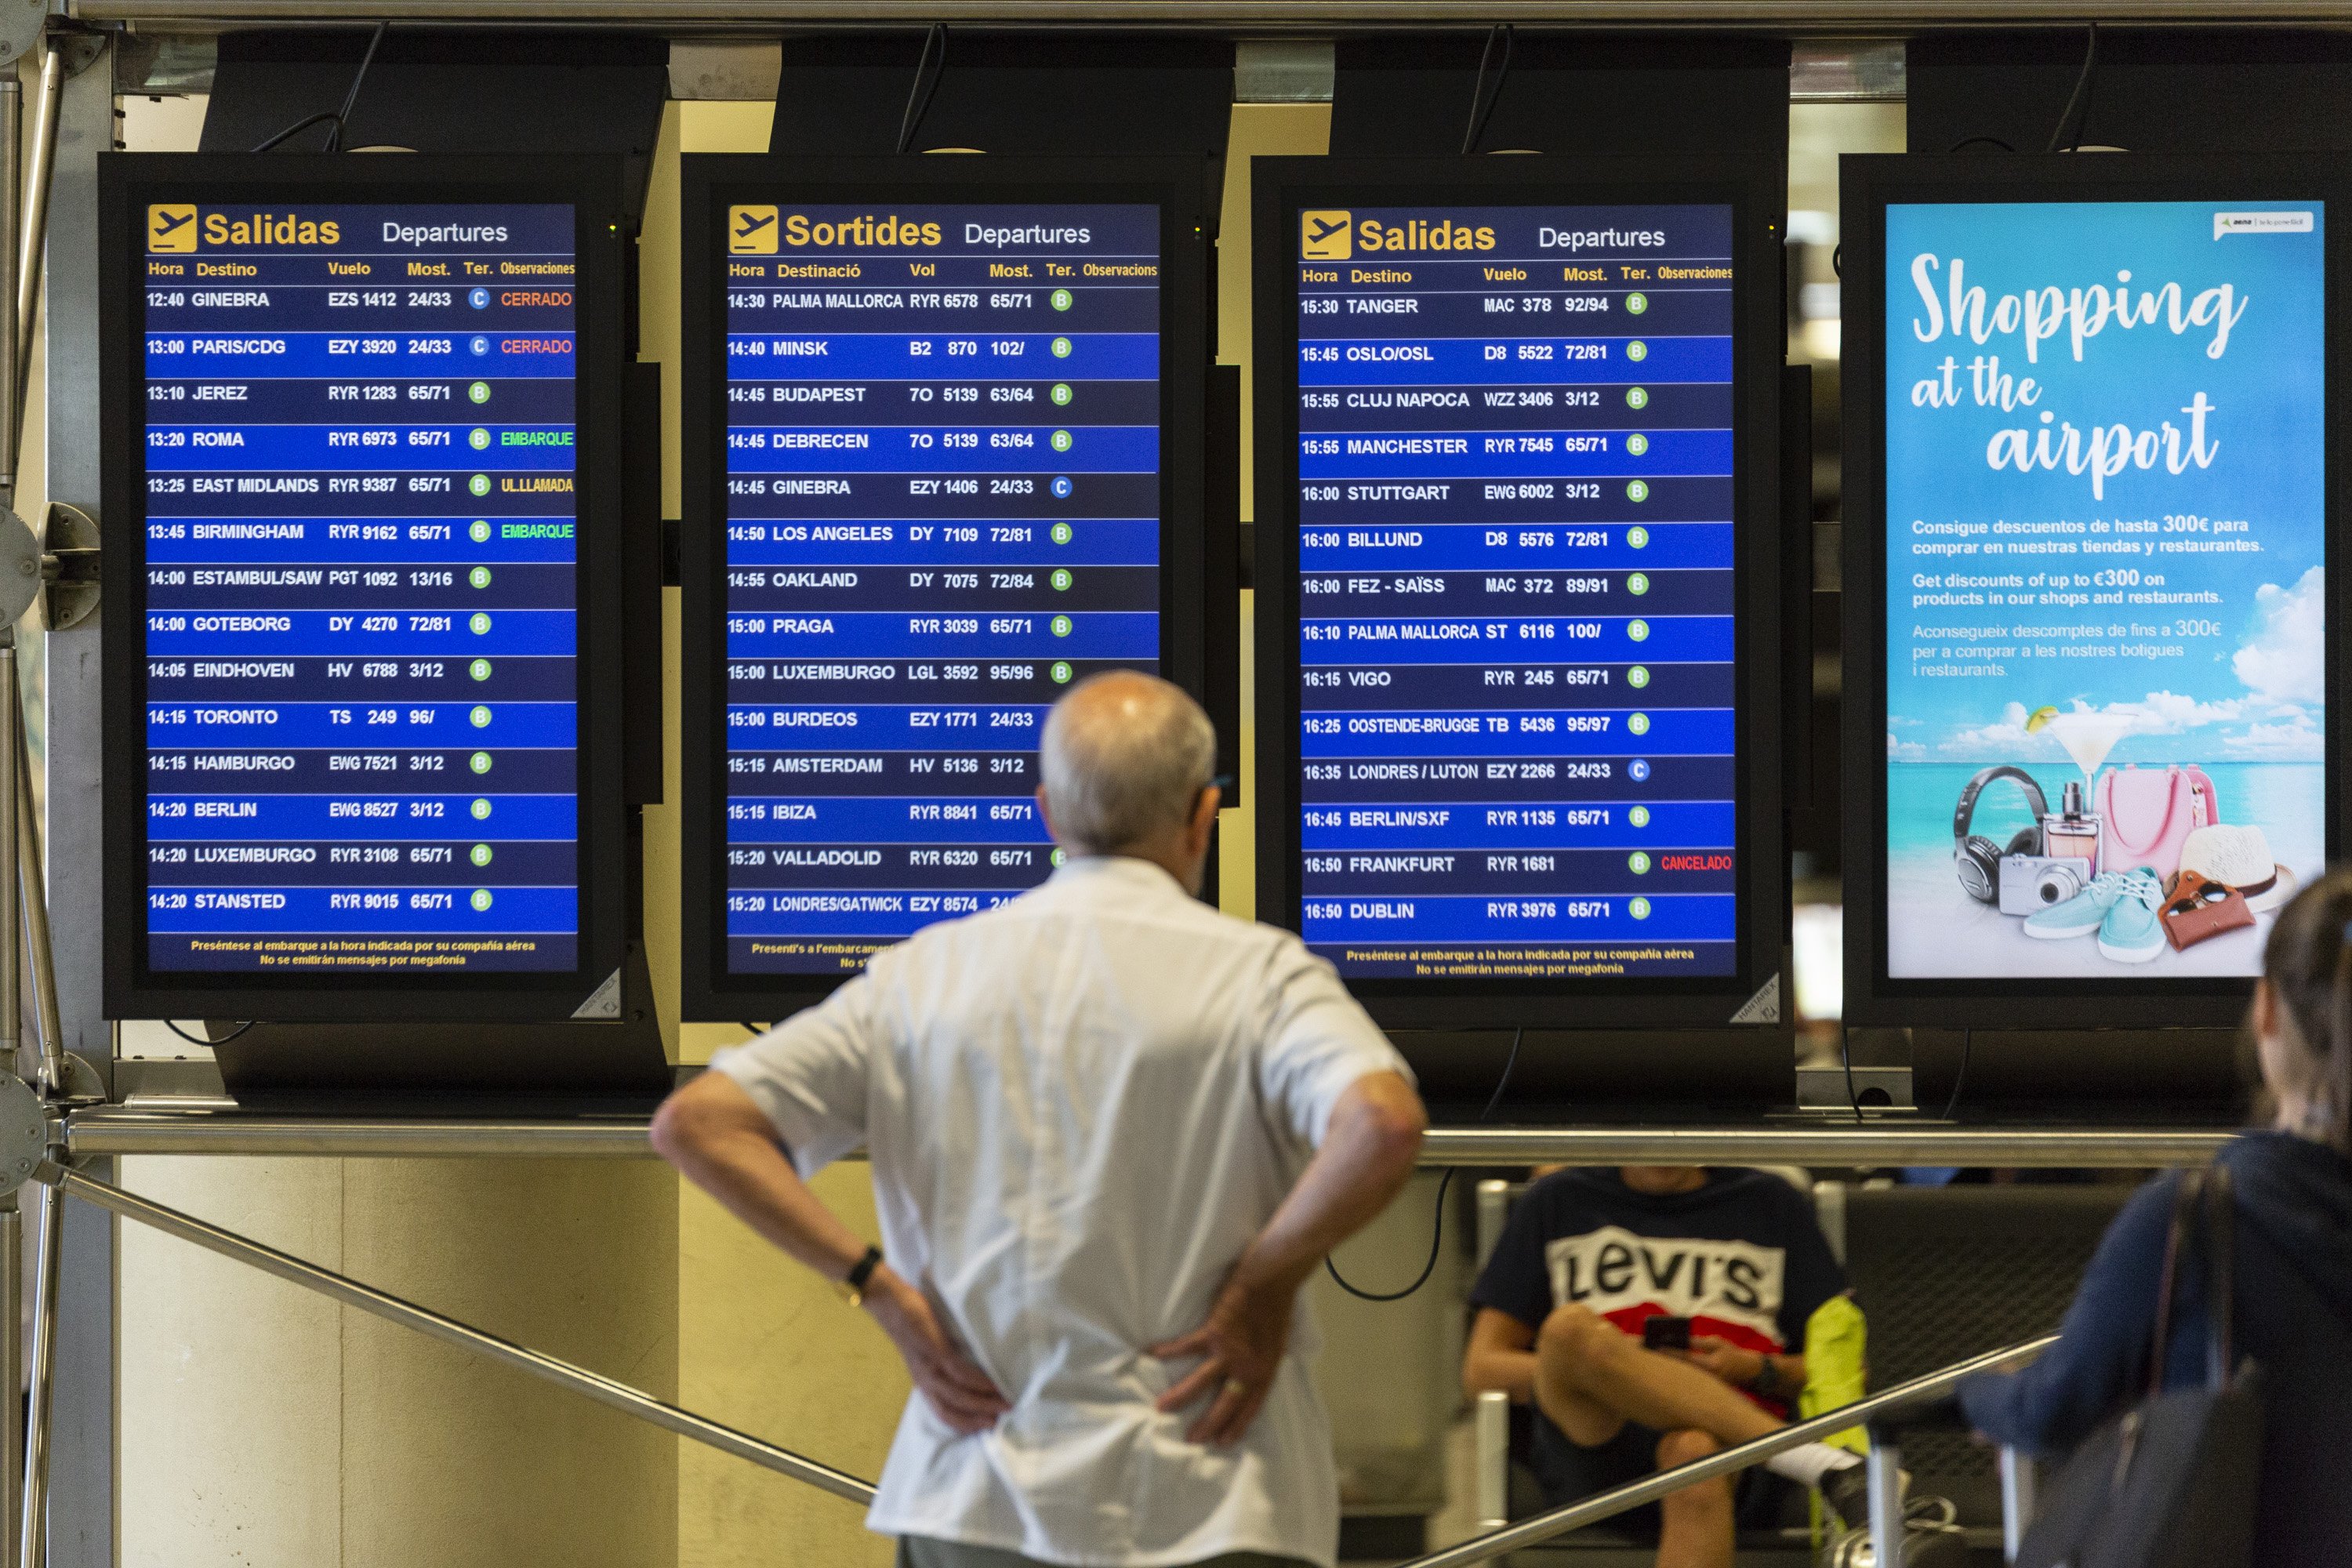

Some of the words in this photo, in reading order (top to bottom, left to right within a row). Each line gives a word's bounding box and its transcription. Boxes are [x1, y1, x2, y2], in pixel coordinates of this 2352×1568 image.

[205, 214, 339, 245] Salidas
[383, 223, 507, 246] Departures
[786, 216, 941, 245] Sortides
[966, 224, 1091, 248] Departures
[1359, 220, 1495, 251] Salidas
[1540, 227, 1665, 252] Departures
[149, 263, 183, 275] Hora
[197, 263, 257, 276] Destino
[328, 263, 371, 274] Vuelo
[408, 263, 450, 275] Most.
[463, 262, 493, 274] Ter.
[501, 262, 575, 274] Observaciones
[730, 264, 764, 276] Hora
[778, 264, 861, 278] Destinació
[910, 263, 935, 276] Vol
[990, 264, 1033, 277] Most.
[1046, 263, 1076, 276] Ter.
[1083, 263, 1157, 276] Observacions
[1303, 270, 1338, 282] Hora
[1352, 270, 1412, 283] Destino
[1484, 267, 1526, 281] Vuelo
[1564, 268, 1607, 281] Most.
[1621, 267, 1650, 279] Ter.
[1658, 267, 1732, 279] Observaciones
[147, 292, 184, 307] 12:40
[192, 292, 270, 307] GINEBRA
[328, 292, 358, 306] EZS
[362, 292, 396, 306] 1412
[408, 292, 451, 306] 24/33
[474, 292, 485, 307] C
[501, 292, 572, 306] CERRADO
[728, 294, 765, 307] 14:30
[773, 294, 822, 307] PALMA
[826, 294, 903, 307] MALLORCA
[910, 294, 939, 307] RYR
[944, 294, 978, 307] 6578
[990, 294, 1031, 307] 65/71
[1056, 294, 1066, 307] B
[1301, 300, 1338, 314] 15:30
[1347, 299, 1418, 313] TANGER
[1485, 298, 1514, 312] MAC
[1523, 298, 1552, 312] 378
[1565, 298, 1609, 311] 92/94
[1632, 297, 1642, 310] B
[1911, 253, 2249, 363] Shopping
[728, 342, 765, 355] 14:40
[773, 342, 828, 355] MINSK
[910, 341, 931, 355] B2
[948, 341, 977, 355] 870
[991, 341, 1025, 355] 102/
[1056, 341, 1066, 354] B
[1911, 356, 1962, 408] at
[1967, 356, 2042, 412] the
[148, 433, 185, 446] 13:20
[193, 433, 245, 446] ROMA
[329, 432, 358, 446] RYR
[362, 432, 397, 445] 6973
[408, 431, 450, 445] 65/71
[475, 433, 485, 446] B
[502, 432, 573, 446] EMBARQUE
[1987, 392, 2220, 500] airport
[148, 479, 185, 492] 13:25
[193, 479, 234, 492] EAST
[238, 478, 319, 492] MIDLANDS
[329, 478, 359, 492] RYR
[362, 478, 397, 492] 9387
[409, 478, 450, 492] 65/71
[475, 479, 485, 492] B
[1912, 520, 1988, 537] Consigue
[1993, 520, 2086, 534] descuentos
[2090, 519, 2110, 533] de
[2114, 519, 2158, 532] hasta
[2163, 515, 2209, 532] 300€
[2213, 521, 2249, 535] para
[1912, 543, 1980, 557] comprar
[1984, 543, 2003, 554] en
[2008, 541, 2078, 554] nuestras
[2082, 539, 2140, 553] tiendas
[2145, 543, 2154, 556] y
[2159, 539, 2263, 552] restaurantes.
[1912, 573, 1941, 588] Get
[1944, 574, 2024, 587] discounts
[2028, 572, 2045, 586] of
[2049, 576, 2070, 590] up
[2074, 574, 2090, 586] to
[2094, 569, 2140, 586] €300
[2144, 575, 2165, 586] on
[1913, 592, 1984, 608] products
[1989, 592, 2003, 604] in
[2008, 594, 2035, 604] our
[2039, 591, 2089, 607] shops
[2093, 590, 2123, 604] and
[2129, 590, 2223, 604] restaurants.
[1913, 625, 2008, 641] Aconsegueix
[2013, 625, 2103, 641] descomptes
[2107, 624, 2126, 637] de
[2130, 623, 2157, 637] fins
[2161, 626, 2171, 637] a
[2176, 619, 2221, 637] 300€
[1913, 648, 1937, 661] per
[1941, 648, 1951, 658] a
[1955, 647, 2016, 660] comprar
[2021, 647, 2031, 657] a
[2035, 644, 2056, 657] les
[2061, 644, 2116, 657] nostres
[2121, 644, 2184, 660] botigues
[728, 666, 765, 679] 15:00
[774, 666, 895, 679] LUXEMBURGO
[909, 666, 938, 680] LGL
[944, 666, 978, 679] 3592
[990, 666, 1033, 679] 95/96
[1056, 666, 1066, 679] B
[1913, 662, 1917, 676] i
[1921, 663, 2007, 677] restaurants.
[149, 710, 186, 724] 14:15
[194, 710, 278, 724] TORONTO
[330, 710, 351, 724] TS
[368, 710, 397, 724] 249
[410, 710, 434, 724] 96/
[476, 711, 486, 724] B
[1305, 858, 1341, 872] 16:50
[1350, 857, 1454, 872] FRANKFURT
[1487, 857, 1517, 871] RYR
[1522, 856, 1554, 871] 1681
[1635, 857, 1645, 869] B
[1661, 855, 1732, 870] CANCELADO
[191, 941, 251, 950] Preséntese
[253, 941, 263, 950] al
[265, 942, 318, 953] embarque
[329, 942, 339, 950] la
[341, 942, 366, 950] hora
[368, 942, 412, 950] indicada
[415, 942, 433, 953] por
[452, 941, 503, 953] compañía
[506, 941, 535, 950] aérea
[752, 944, 805, 953] Presenti's
[260, 955, 275, 964] No
[292, 955, 335, 964] emitirán
[337, 956, 387, 967] mensajes
[390, 956, 408, 967] por
[411, 955, 466, 967] megafonía
